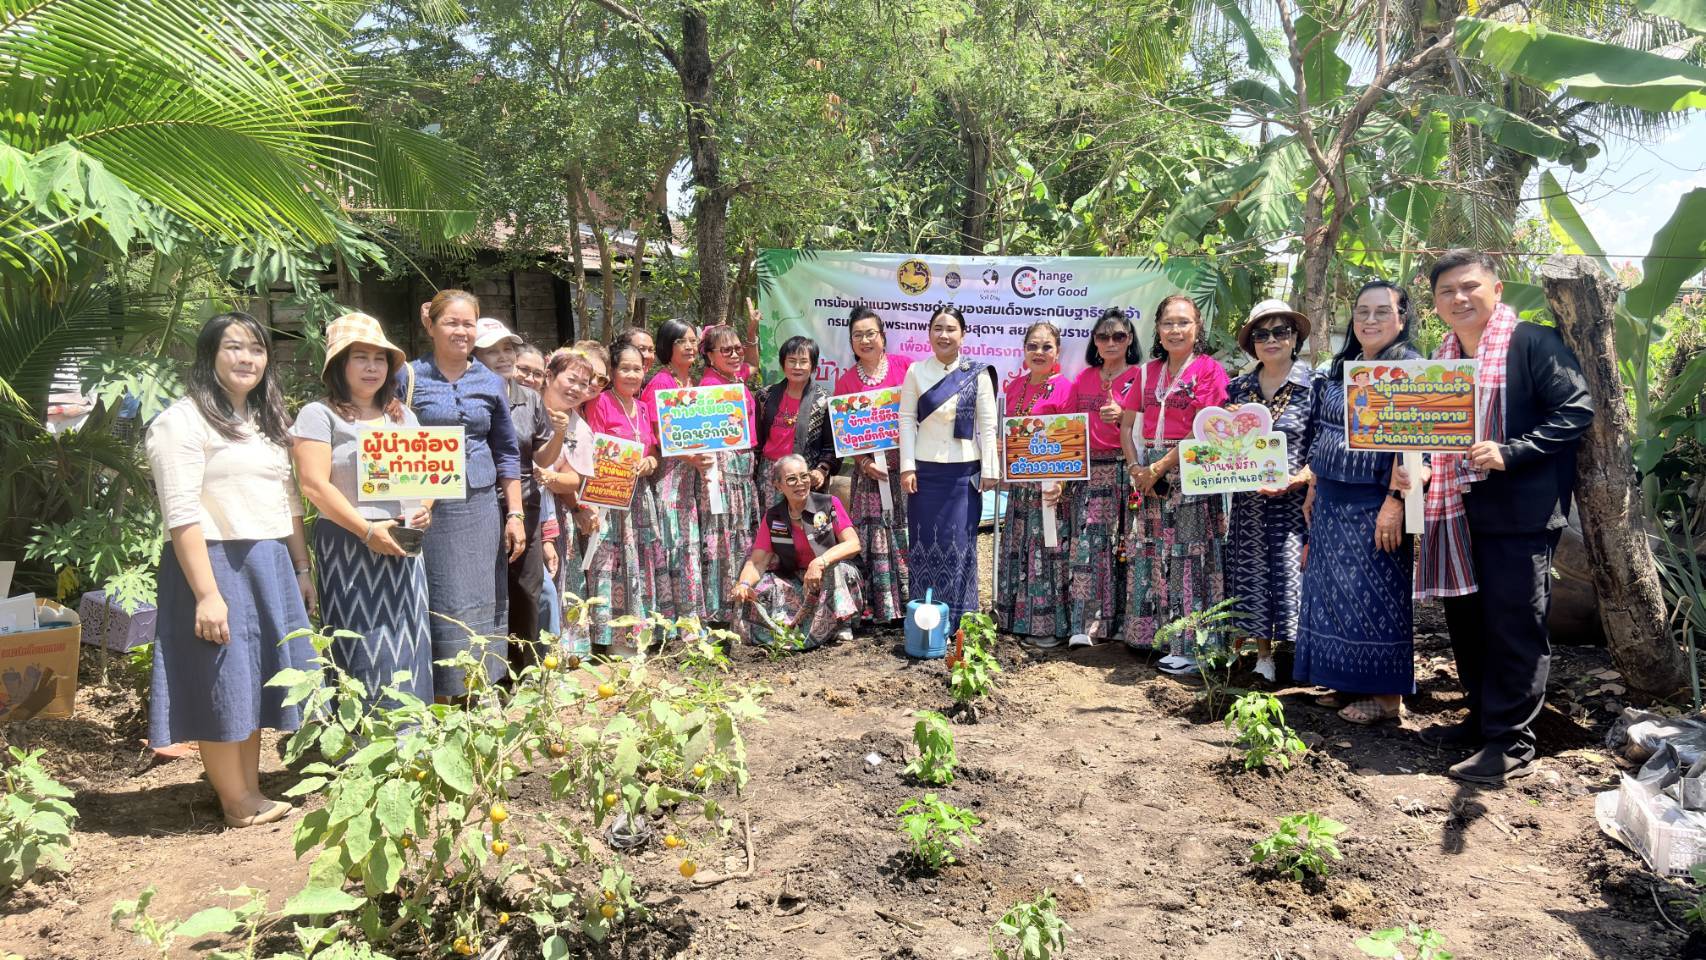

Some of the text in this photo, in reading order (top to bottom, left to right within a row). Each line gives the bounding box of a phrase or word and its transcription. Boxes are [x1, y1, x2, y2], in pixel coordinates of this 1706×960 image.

[1038, 285, 1088, 297] for Good
[1373, 378, 1472, 399] ปลูกผักสวนครัว
[1378, 401, 1468, 422] เพื่อสร้างความ
[671, 420, 740, 448] ผู้คนรักกัน
[1029, 430, 1062, 455] ที่ว่าง
[1373, 424, 1473, 445] มั่นคงทางอาหาร
[363, 431, 459, 461] ผู้นำต้อง
[389, 454, 455, 473] ทำก่อน
[1010, 457, 1083, 475] สร้างอาหาร
[1201, 453, 1258, 473] บ้านนี้มีรัก
[1192, 471, 1263, 489] ปลูกผักกินเอง
